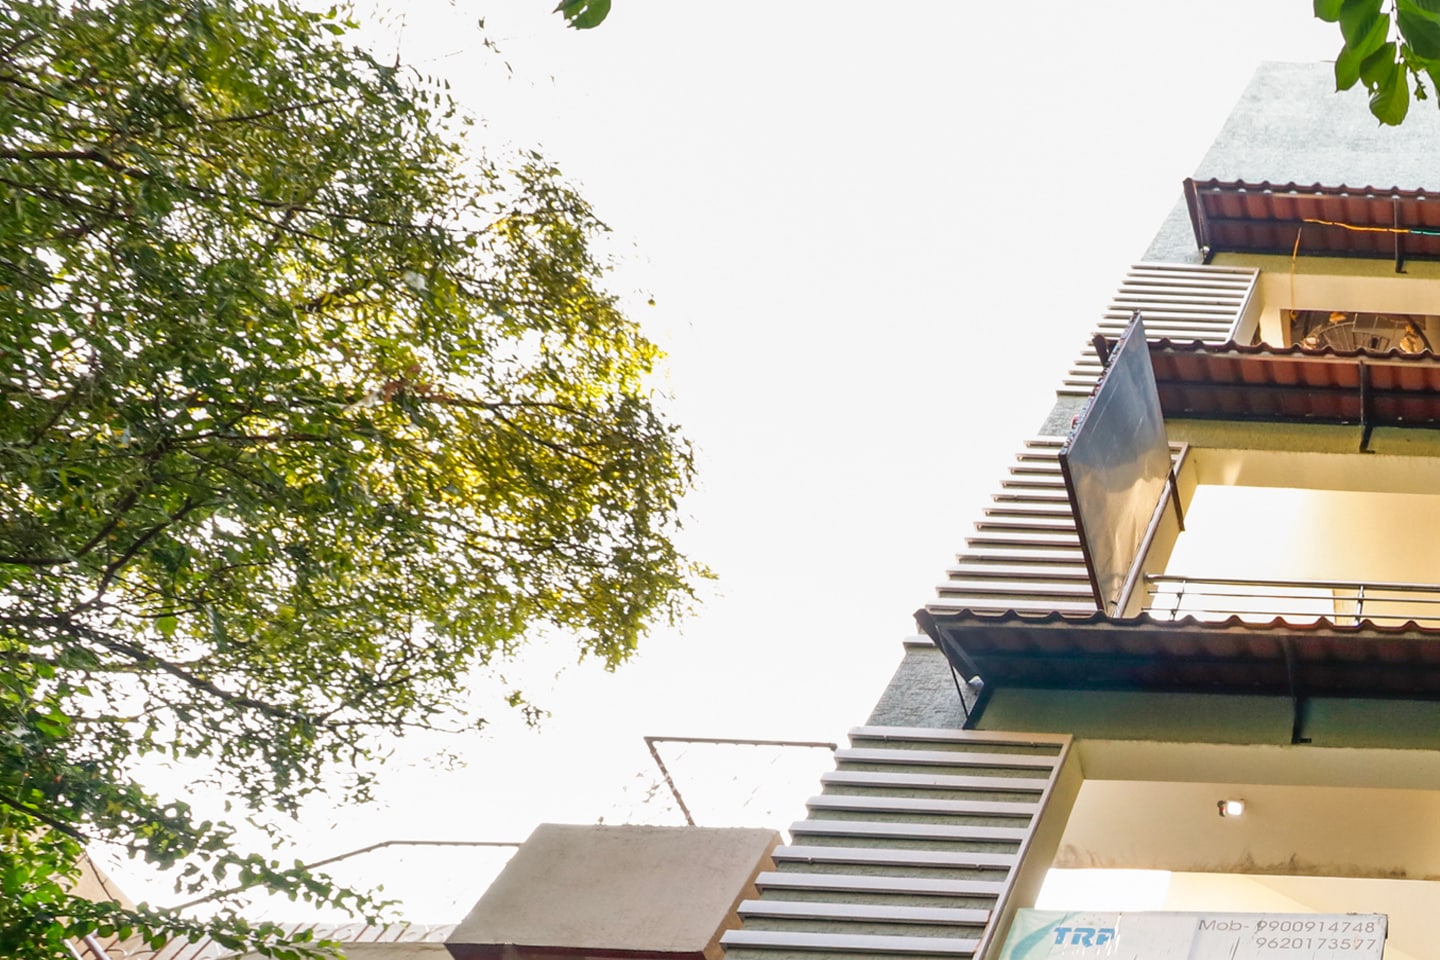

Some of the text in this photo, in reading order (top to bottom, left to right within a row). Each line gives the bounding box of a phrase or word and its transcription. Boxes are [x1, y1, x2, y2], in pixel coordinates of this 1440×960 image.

[1199, 919, 1375, 933] Mob- 9900914748
[1256, 937, 1376, 950] 9620173577
